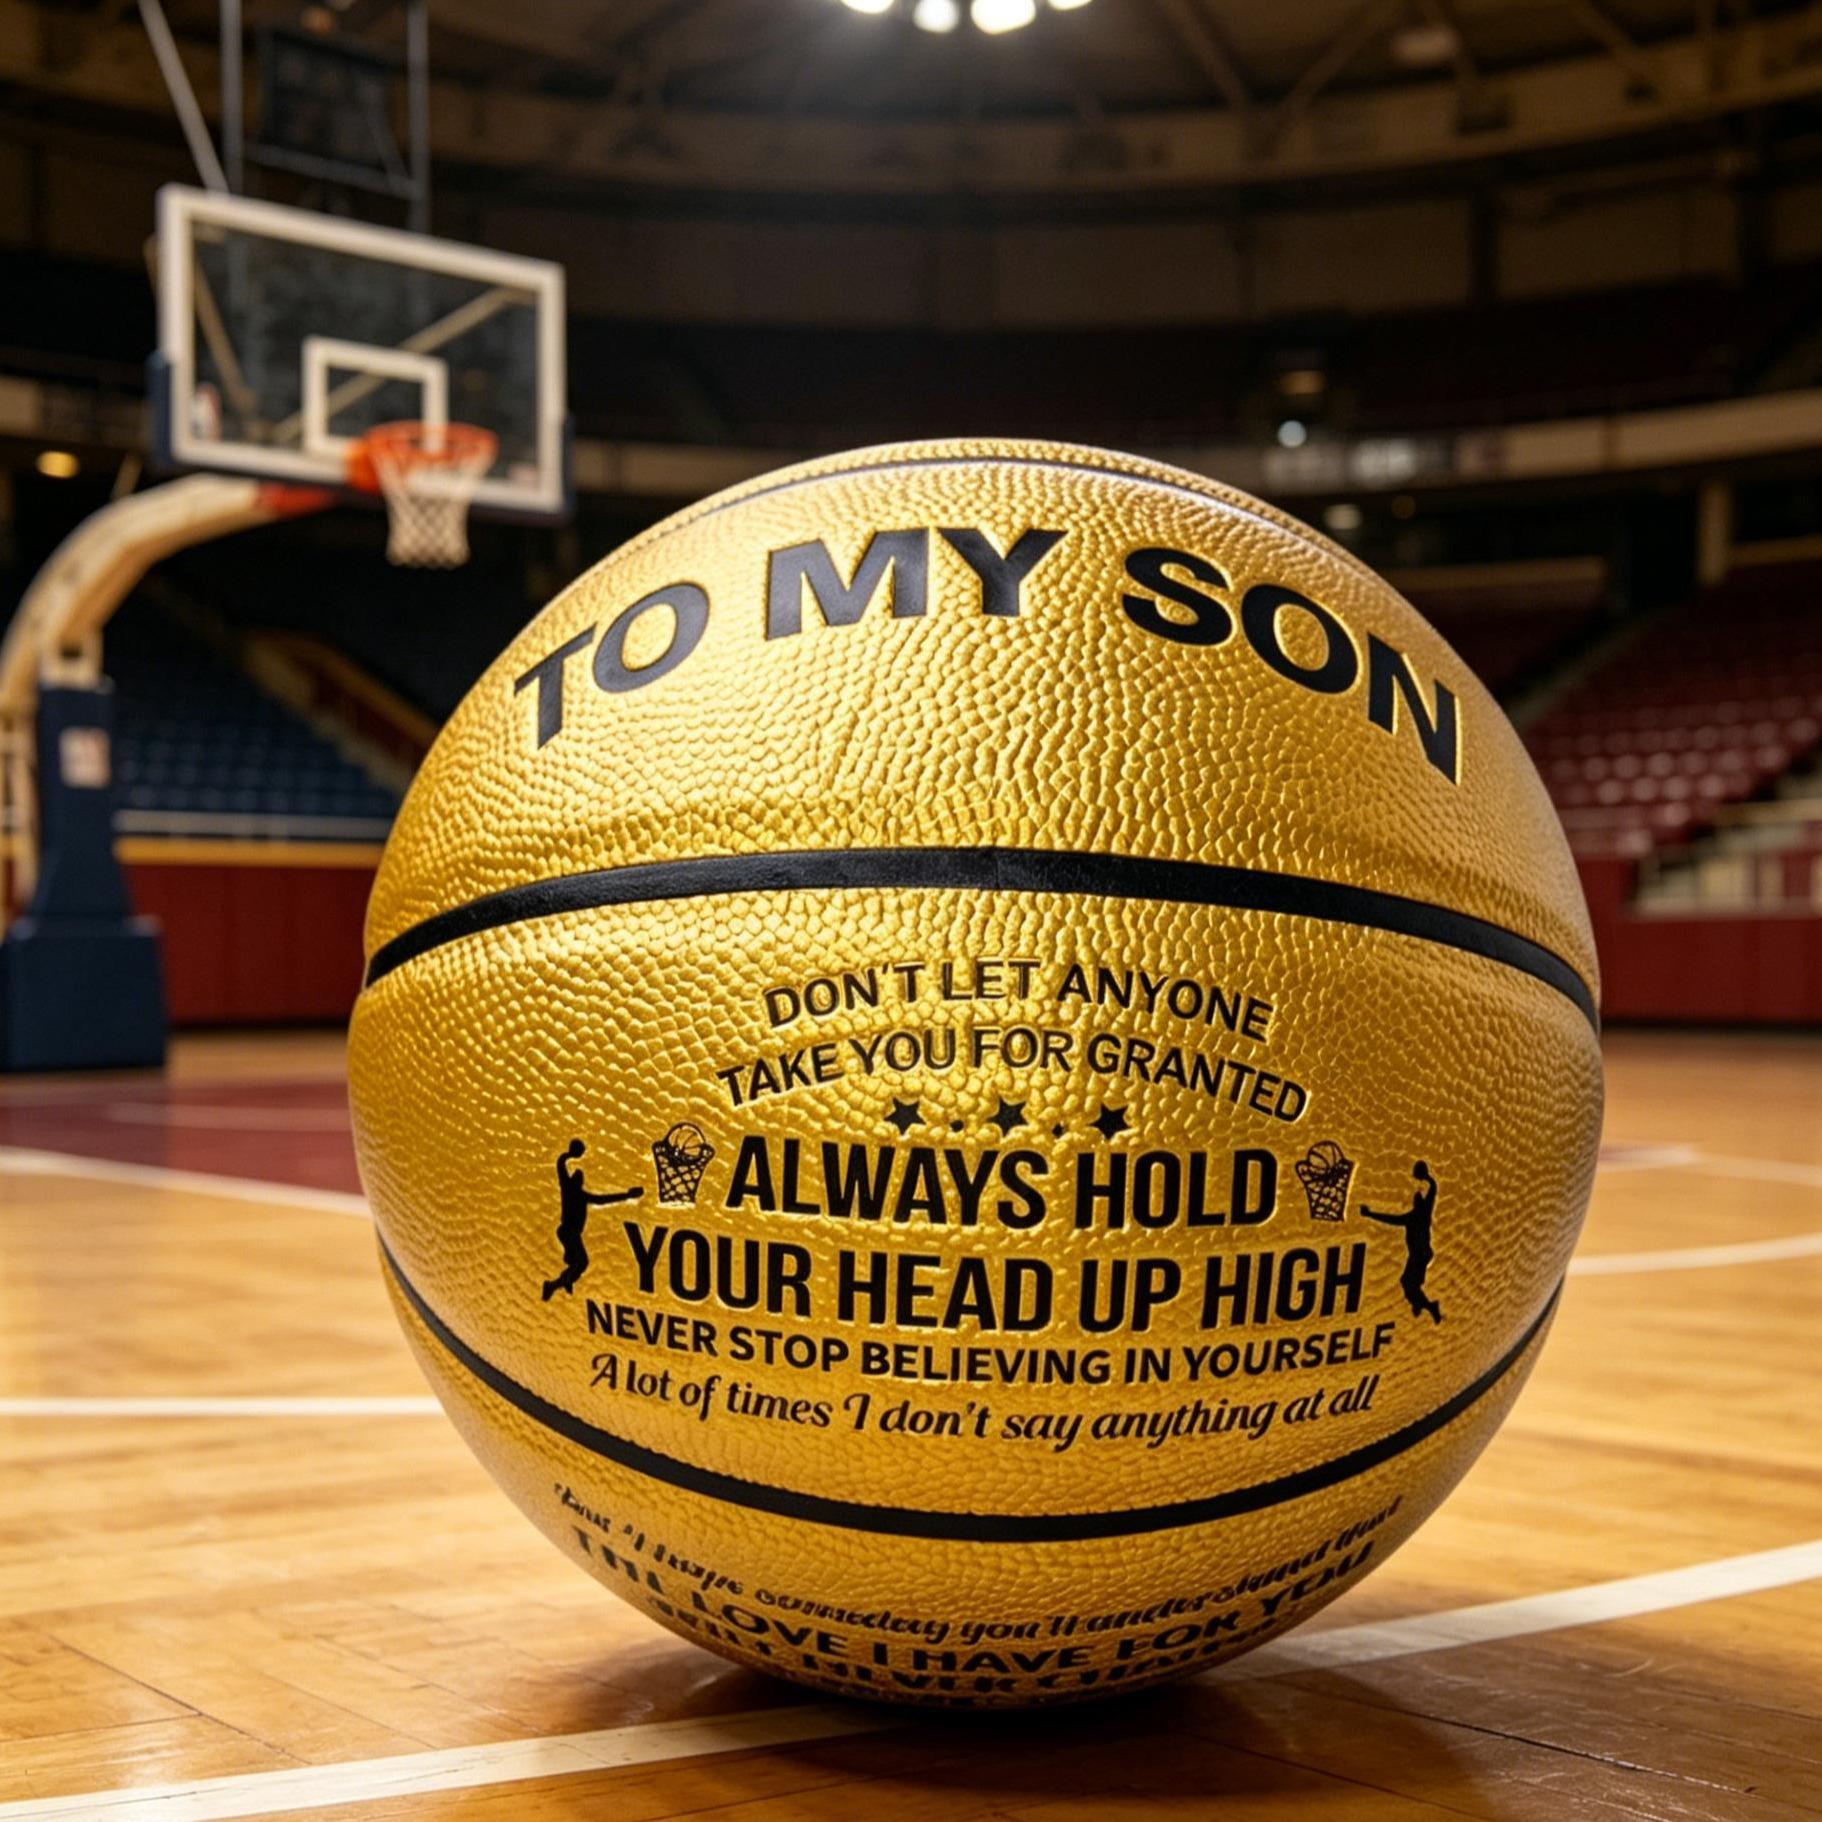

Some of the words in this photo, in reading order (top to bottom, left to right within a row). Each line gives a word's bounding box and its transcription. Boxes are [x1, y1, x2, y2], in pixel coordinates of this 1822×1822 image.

[514, 582, 711, 747] TO
[764, 528, 1068, 639] MY
[1123, 547, 1458, 784] SON
[764, 961, 925, 1028] DON'T
[943, 960, 1040, 1001] LET
[1060, 964, 1273, 1041] ANYONE
[716, 1044, 844, 1107] TAKE
[850, 1028, 956, 1075] YOU
[972, 1028, 1074, 1072] FOR
[1086, 1031, 1309, 1123] GRANTED
[726, 1135, 1050, 1230] ALWAYS
[1075, 1147, 1279, 1229] HOLD
[623, 1222, 812, 1317] YOUR
[836, 1250, 1054, 1332] HEAD
[1078, 1258, 1183, 1333] UP
[1200, 1243, 1367, 1331] HIGH
[586, 1299, 718, 1357] NEVER
[728, 1326, 850, 1373] STOP
[860, 1341, 1111, 1384] BELIEVING
[1124, 1348, 1172, 1384] IN
[1183, 1321, 1396, 1381] YOURSELF
[590, 1352, 618, 1391] A
[625, 1359, 671, 1399] lot
[678, 1374, 722, 1421] of
[727, 1383, 834, 1428] times
[879, 1400, 992, 1438] don't
[1000, 1412, 1083, 1453] say
[1090, 1398, 1279, 1449] anything
[1283, 1386, 1326, 1424] at
[1328, 1373, 1381, 1417] all
[692, 1592, 849, 1654] LOVE
[872, 1642, 889, 1666] I
[912, 1646, 1096, 1674] HAVE
